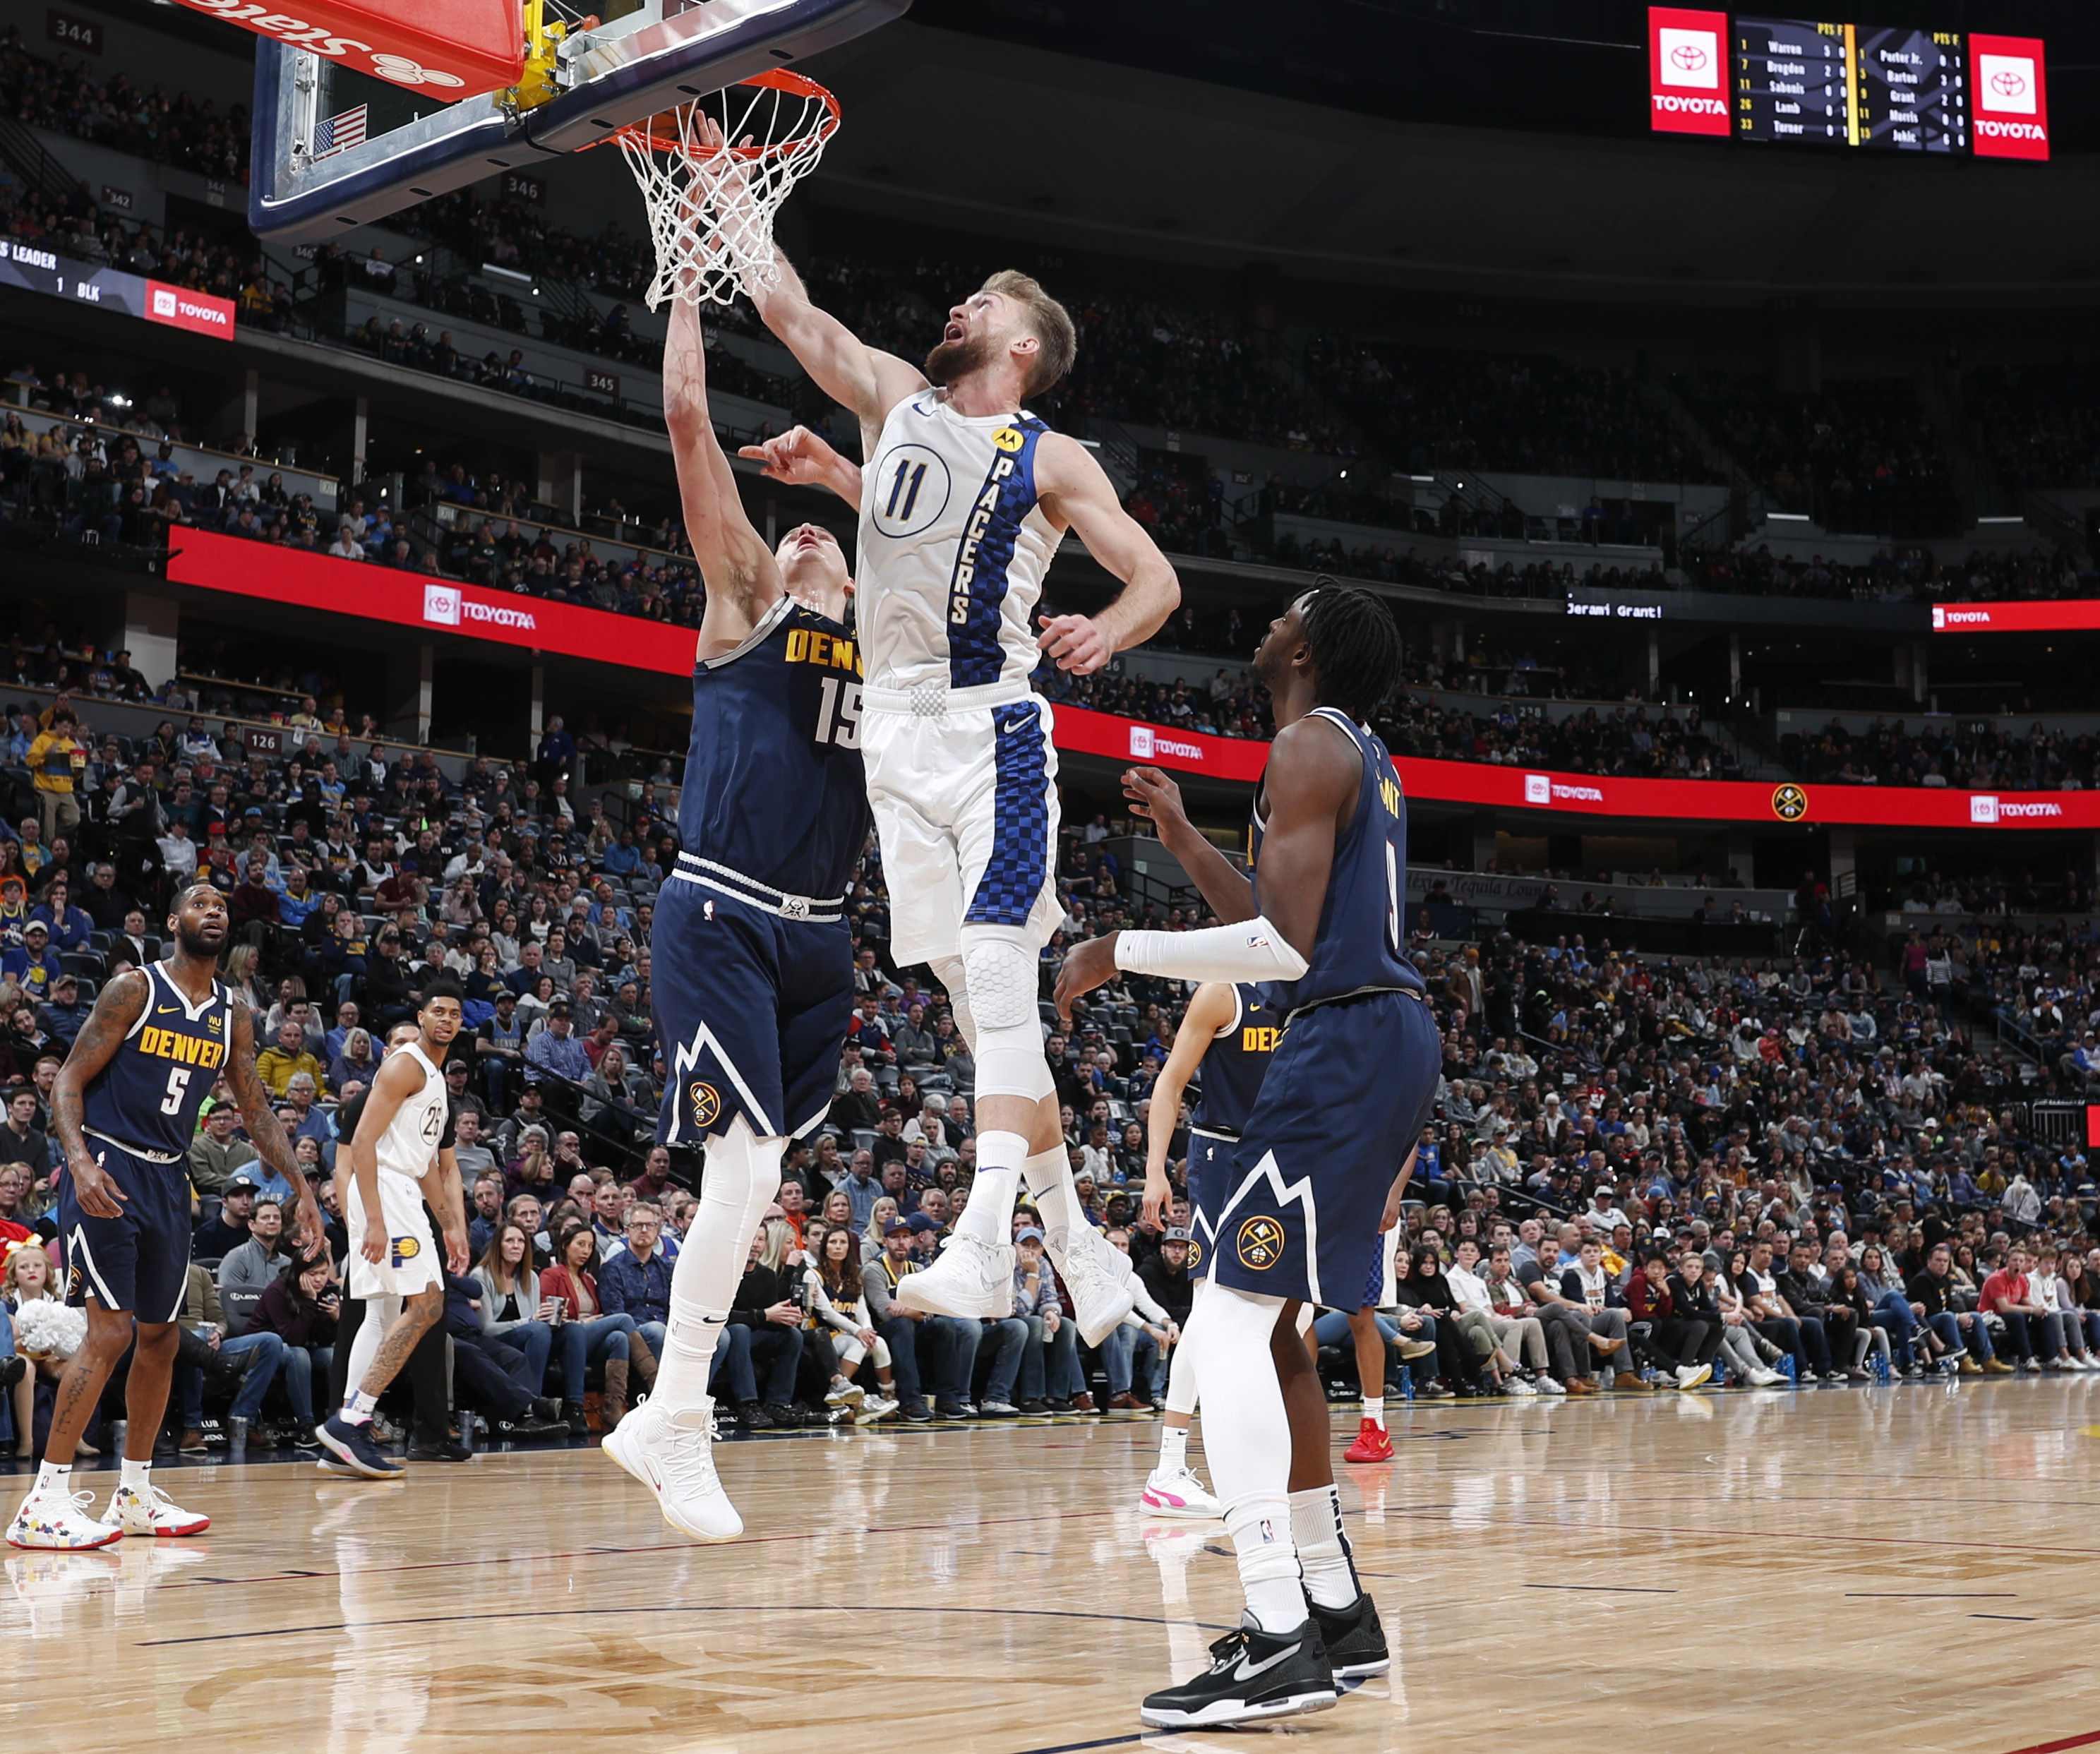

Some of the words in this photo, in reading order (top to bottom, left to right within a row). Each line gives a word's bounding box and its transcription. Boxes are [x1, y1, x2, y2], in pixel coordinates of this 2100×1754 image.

[56, 20, 92, 44] 344
[1818, 23, 1835, 35] PTS
[1837, 24, 1844, 36] F
[1933, 32, 1950, 45] PTS
[1952, 33, 1960, 46] F
[1741, 39, 1747, 50] 1
[1768, 40, 1802, 55] Warren
[1839, 46, 1846, 59] 0
[1859, 48, 1865, 60] 1
[1880, 49, 1909, 64] Porter
[1911, 52, 1923, 65] Jr.
[1939, 54, 1947, 67] 0
[1955, 56, 1961, 68] 1
[1741, 58, 1748, 71] 7
[1767, 60, 1805, 76] Brogdon
[1825, 65, 1831, 77] 2
[1840, 66, 1847, 78] 0
[1740, 78, 1751, 90] 11
[1770, 80, 1805, 95] Sabonis
[1825, 85, 1832, 97] 0
[1840, 85, 1847, 98] 0
[1887, 69, 1918, 84] Barton
[1955, 75, 1962, 88] 0
[1652, 95, 1728, 115] TOYOTA
[1740, 98, 1752, 110] 26
[1775, 100, 1801, 114] Lamb
[1825, 104, 1833, 117] 0
[1842, 106, 1847, 118] 1
[1890, 90, 1916, 104] Grant
[1941, 94, 1948, 107] 2
[1956, 95, 1963, 107] 0
[1859, 107, 1870, 119] 11
[1942, 113, 1950, 126] 0
[1957, 114, 1964, 127] 0
[1740, 118, 1753, 130] 33
[1773, 120, 1804, 134] Turner
[1826, 124, 1834, 137] 0
[1842, 126, 1848, 138] 1
[1893, 129, 1916, 143] Jokic
[1957, 134, 1965, 147] 0
[1974, 119, 2046, 140] TOYOTA
[508, 177, 538, 199] 346
[110, 192, 131, 207] 342
[12, 244, 56, 270] LEADER
[56, 277, 64, 293] 1
[77, 282, 100, 302] BLK
[179, 302, 226, 325] TOYOTA
[591, 374, 615, 390] 345
[884, 458, 929, 522] 11
[950, 456, 1014, 625] PACERS
[461, 601, 536, 630] TOYOTA
[1567, 603, 1610, 616] Jerami
[1616, 605, 1662, 618] Grant!
[1946, 611, 1991, 623] TOYOTA
[1104, 660, 1120, 672] 36
[815, 676, 863, 750] 15
[1969, 723, 1984, 734] 40
[251, 733, 275, 750] 126
[1153, 738, 1204, 759] TOYOTA
[1550, 783, 1604, 802] TOYOTA
[1999, 803, 2062, 817] TOYOTA
[1451, 877, 1501, 899] Tequila
[1506, 882, 1546, 897] Loun
[208, 1014, 222, 1026] WU
[139, 1026, 224, 1069] DENVER
[160, 1067, 192, 1115] 5
[424, 1106, 441, 1136] 26
[201, 1419, 220, 1428] LUB
